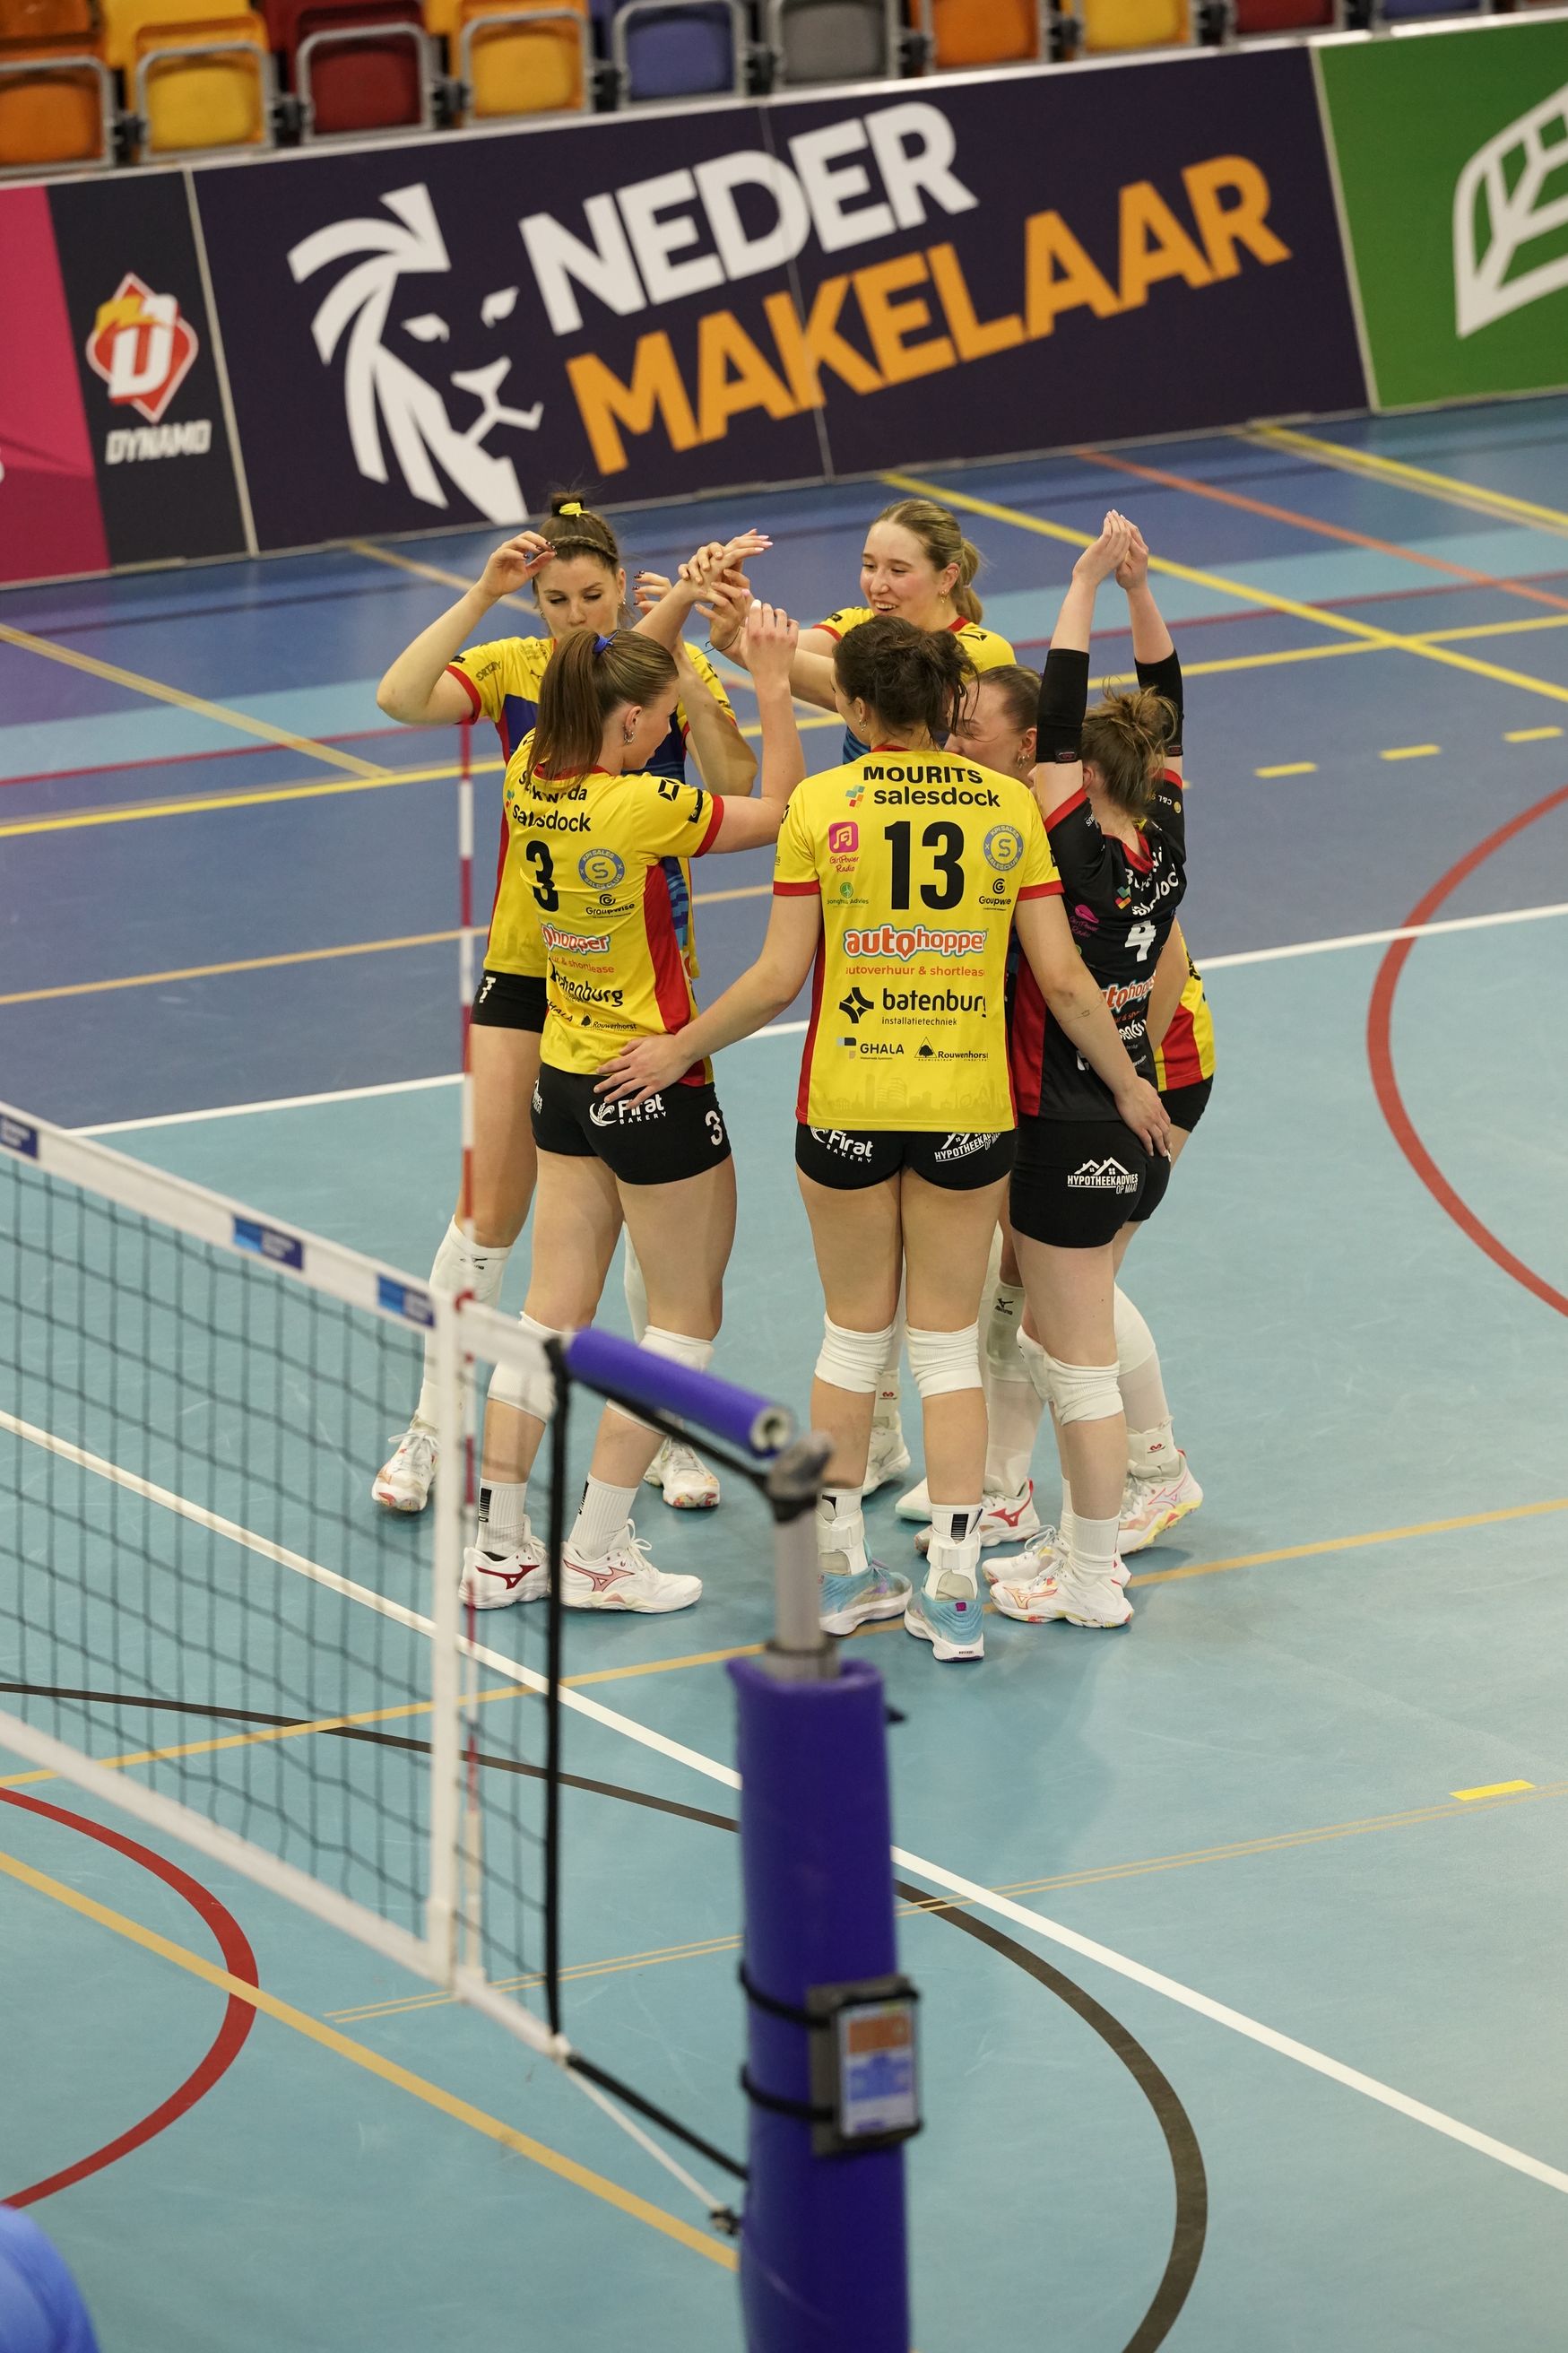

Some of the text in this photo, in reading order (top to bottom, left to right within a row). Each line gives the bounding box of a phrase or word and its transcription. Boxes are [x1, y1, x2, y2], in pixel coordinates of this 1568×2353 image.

[518, 101, 979, 335] NEDER
[565, 154, 1293, 476] MAKELAAR
[105, 419, 212, 465] DYNAMO
[863, 766, 983, 784] MOURITS
[873, 786, 1001, 808] salesdock
[525, 839, 559, 913] 3
[884, 821, 965, 911] 13
[1124, 920, 1157, 962] 4
[918, 966, 927, 975] &
[930, 966, 985, 977] shortleas
[881, 1016, 957, 1026] installatietechniek
[860, 1043, 905, 1055] GHALA
[938, 1050, 988, 1059] Rouwenhors
[619, 1111, 668, 1124] BAKERY
[705, 1109, 723, 1146] 3
[826, 1144, 872, 1163] BAKERY
[1067, 1173, 1139, 1186] HYPOTHEEKADVIES
